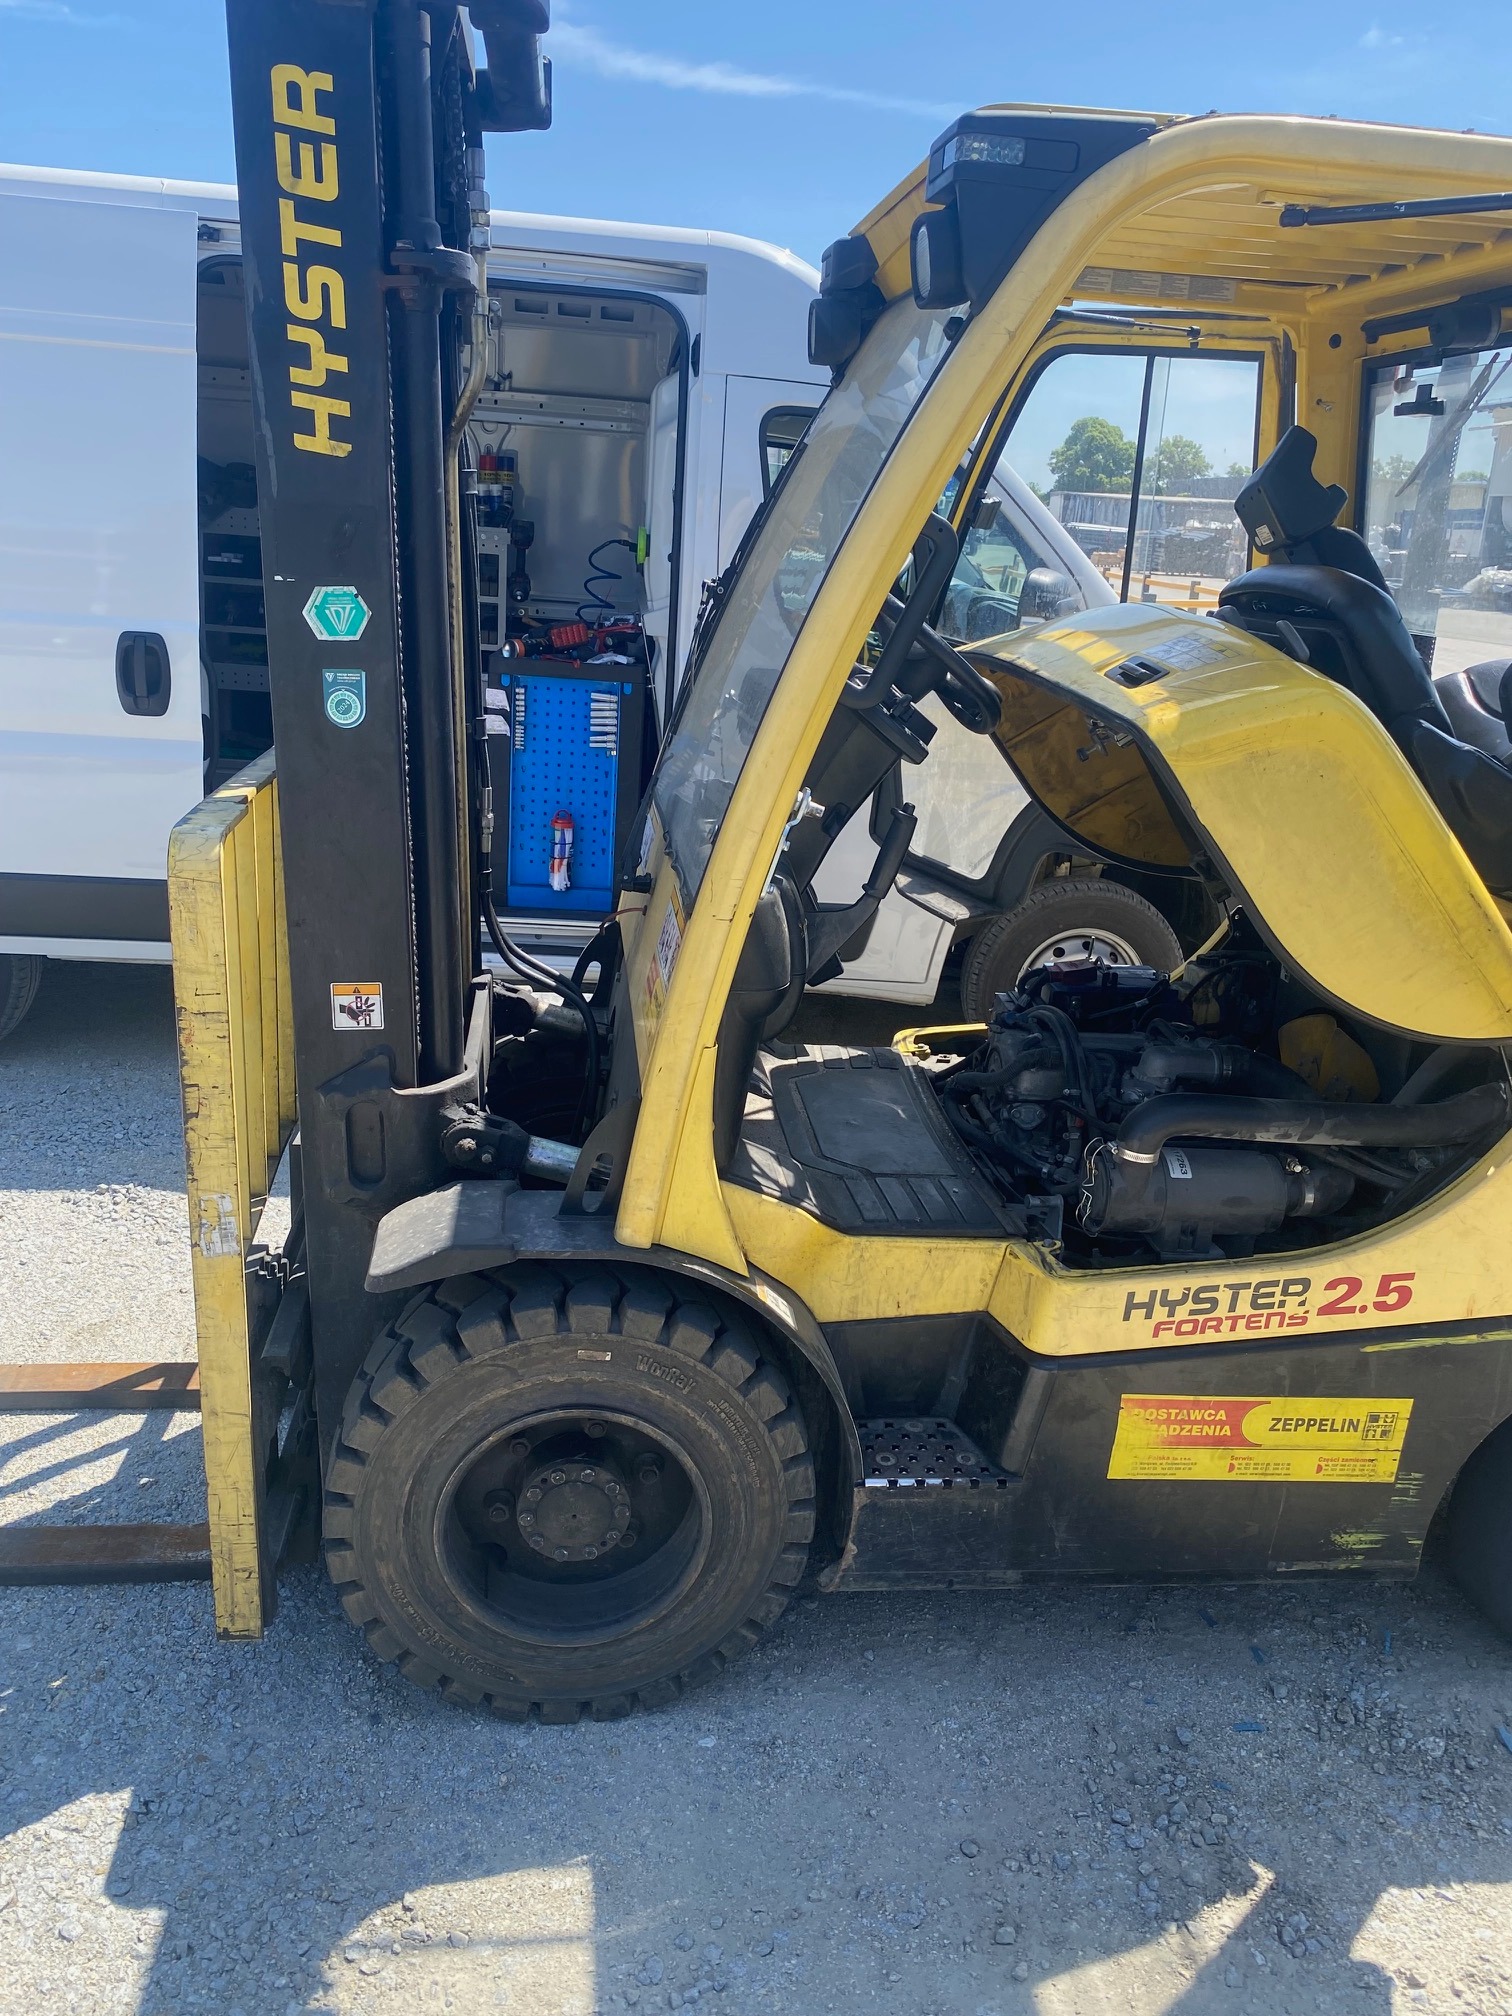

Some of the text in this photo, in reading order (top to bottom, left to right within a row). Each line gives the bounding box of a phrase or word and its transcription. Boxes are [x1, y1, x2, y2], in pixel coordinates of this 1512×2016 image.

[270, 63, 353, 458] HYSTER
[1122, 1272, 1416, 1321] HYSTER 2.5
[1152, 1310, 1309, 1338] FORTENS
[636, 1354, 696, 1395] WonRay
[1268, 1417, 1361, 1433] ZEPPELIN
